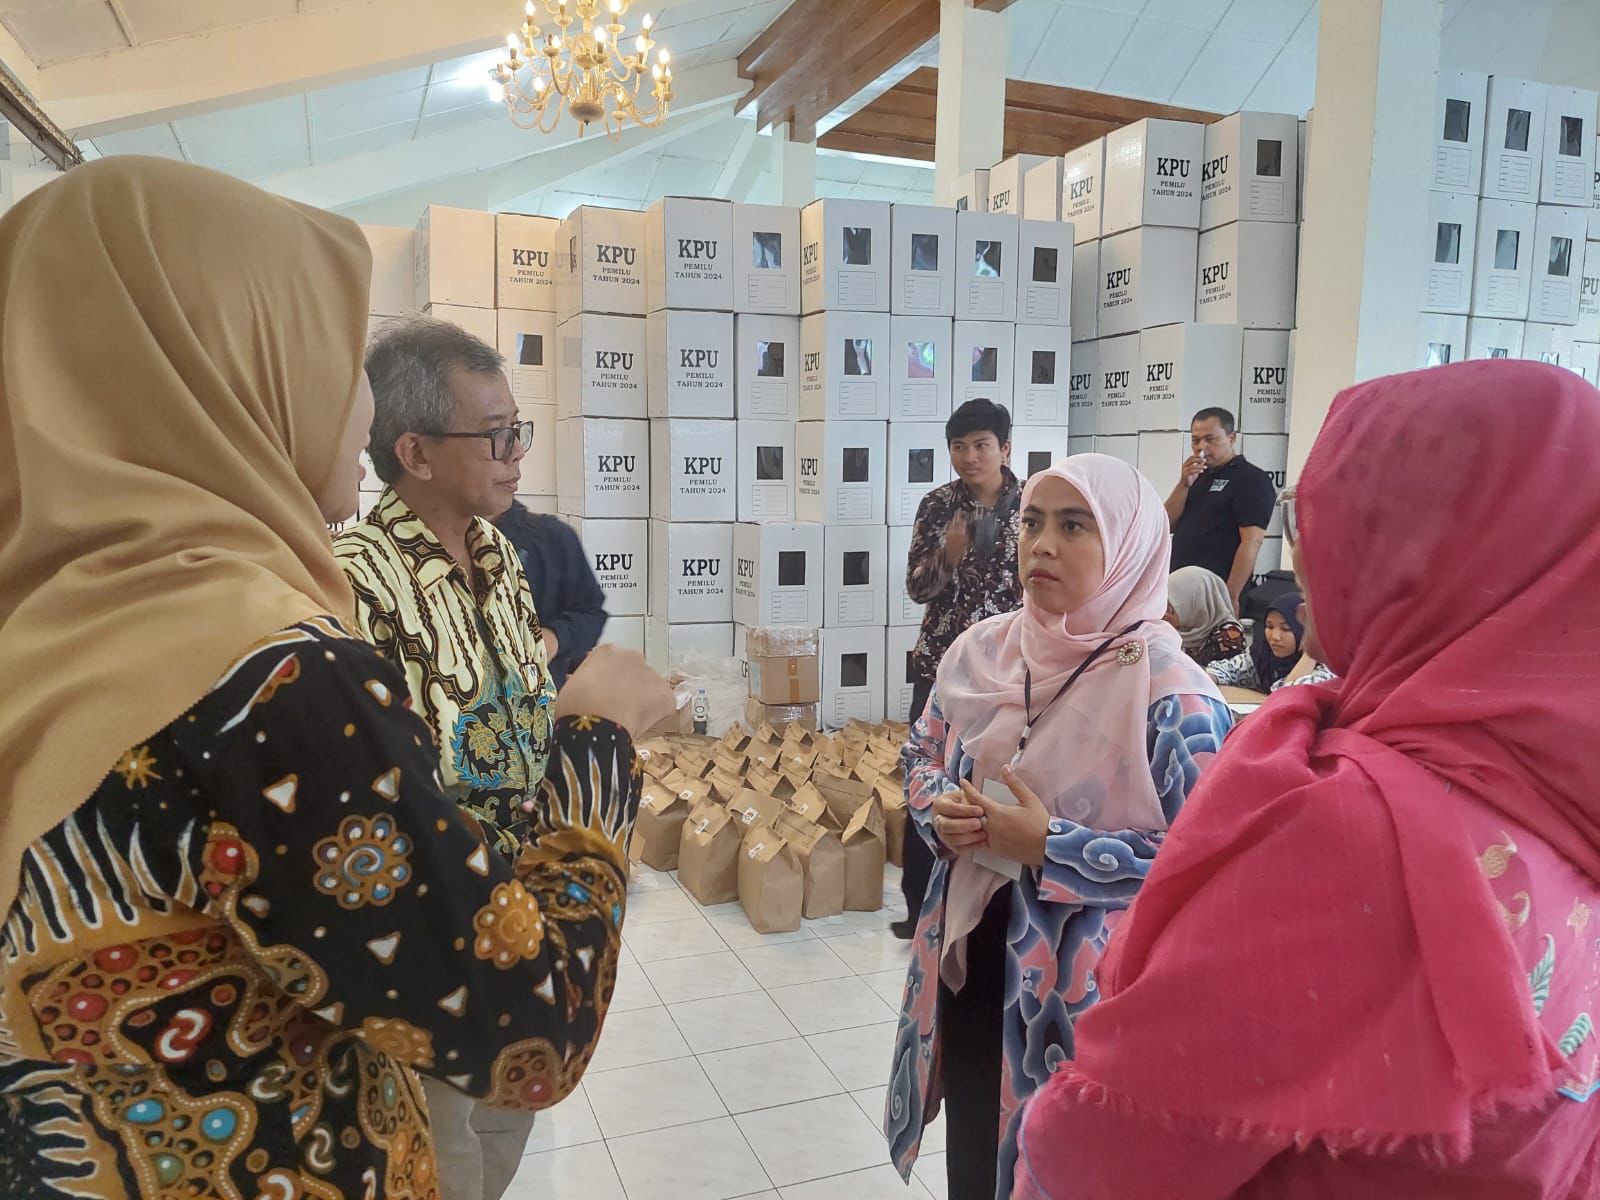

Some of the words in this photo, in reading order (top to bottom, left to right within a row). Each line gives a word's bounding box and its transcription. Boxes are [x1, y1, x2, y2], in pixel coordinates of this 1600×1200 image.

[1157, 158, 1190, 177] KPU
[1202, 155, 1228, 182] KPU
[1070, 176, 1094, 200] KPU
[1205, 180, 1225, 192] PEMILU
[1218, 186, 1231, 195] 2024
[993, 190, 1010, 210] KPU
[1073, 198, 1089, 208] PEMILU
[512, 249, 548, 267] KPU
[597, 244, 636, 265] KPU
[678, 240, 717, 259] KPU
[804, 242, 818, 266] KPU
[602, 267, 631, 275] PEMILU
[1106, 268, 1130, 290] KPU
[1202, 262, 1228, 285] KPU
[1109, 290, 1127, 299] PEMILU
[1206, 285, 1225, 295] PEMILU
[1582, 277, 1599, 295] PU
[1103, 300, 1118, 308] TAHUN
[1200, 296, 1216, 304] TAHUN
[1218, 292, 1231, 300] 2024
[596, 351, 633, 370] KPU
[680, 349, 718, 368] KPU
[805, 352, 820, 372] KPU
[1104, 371, 1129, 389] KPU
[1147, 362, 1173, 382] KPU
[1253, 367, 1285, 385] KPU
[598, 456, 635, 472] KPU
[684, 457, 722, 474] KPU
[801, 458, 818, 476] KPU
[1267, 471, 1285, 488] PU
[596, 554, 632, 570] KPU
[682, 559, 720, 576] KPU
[738, 558, 754, 578] KPU
